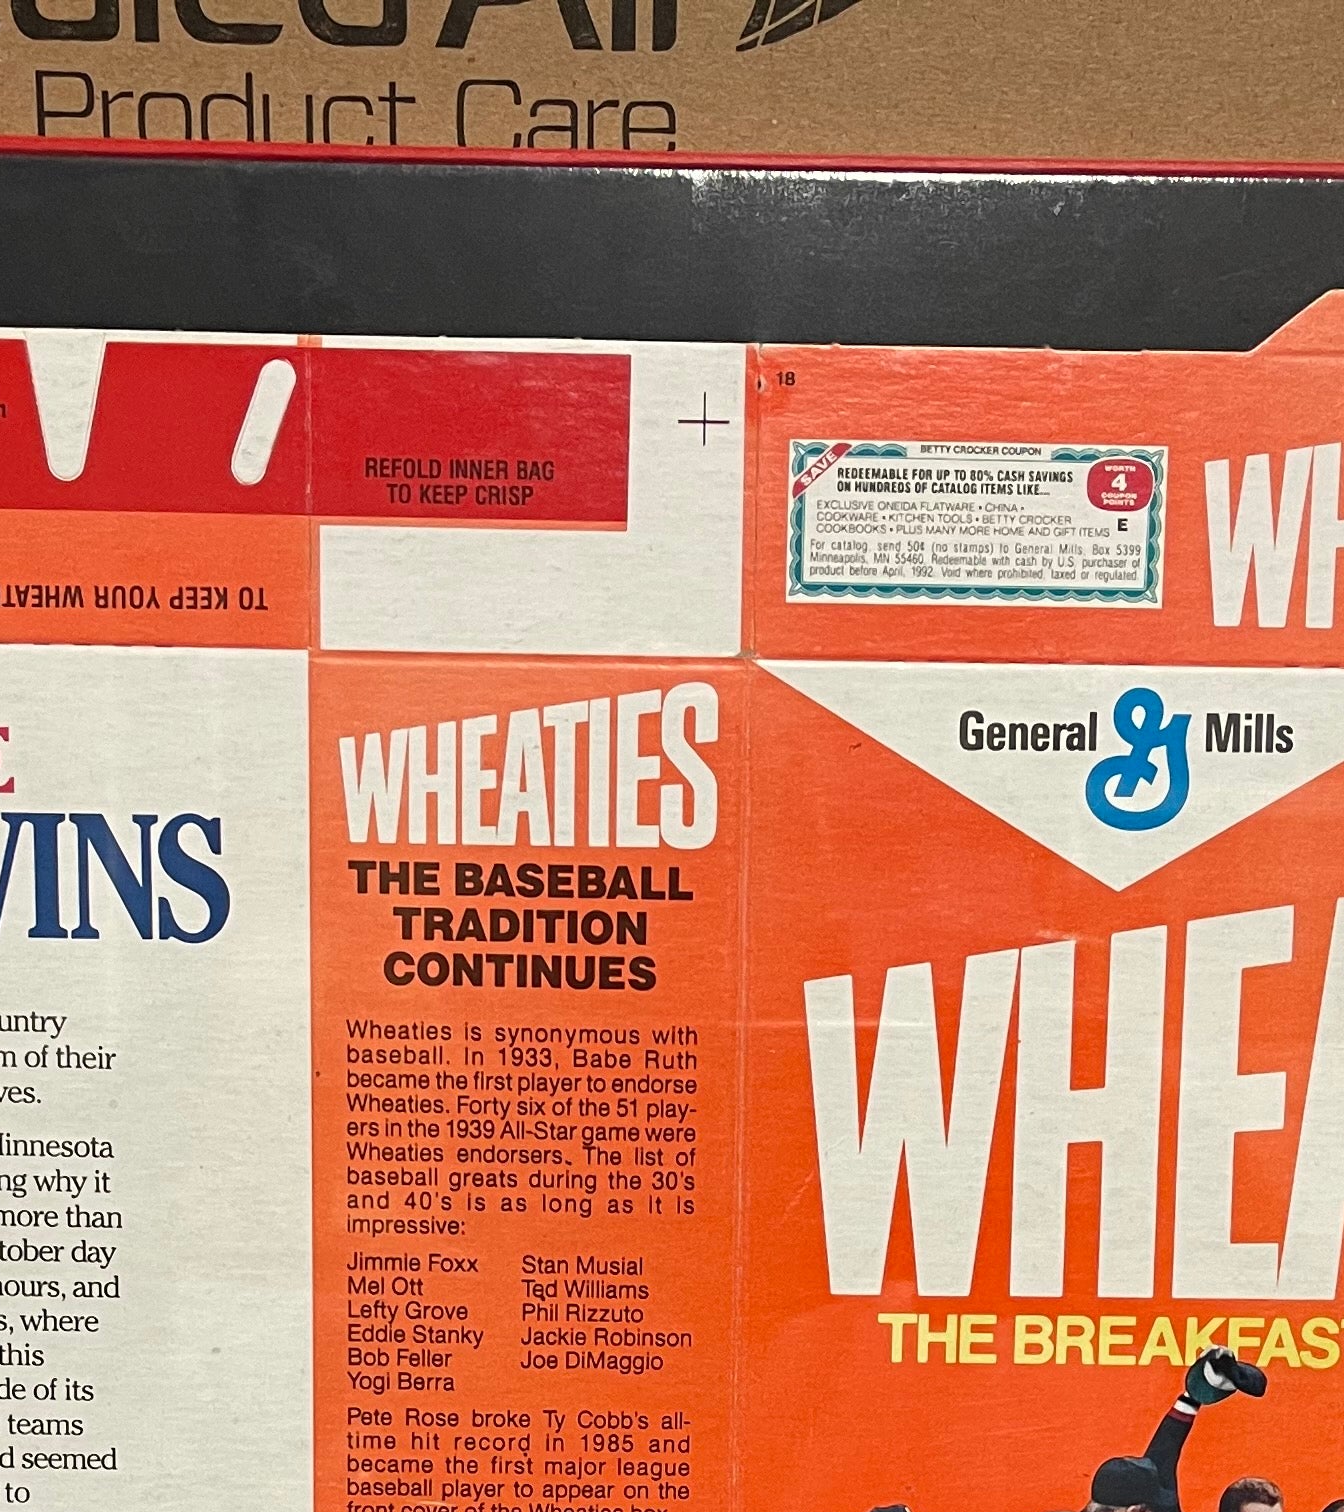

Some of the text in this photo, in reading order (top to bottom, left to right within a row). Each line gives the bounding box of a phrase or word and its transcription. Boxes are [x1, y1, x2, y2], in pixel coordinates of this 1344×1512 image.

[35, 70, 676, 151] Product Care
[776, 371, 795, 386] 18
[921, 445, 1042, 456] BETTY CROCKER COUPON
[365, 457, 555, 481] REFOLD INNER BAG
[800, 450, 838, 486] SAVE
[838, 468, 1073, 483] REDEEMABLE FOR UP TO 80% CASH SAVINGS
[385, 484, 534, 505] TO KEEP CRISP
[94, 584, 160, 609] YOUR
[170, 585, 227, 610] KEEP
[239, 586, 268, 610] TO
[959, 711, 1294, 753] General Mills
[339, 682, 719, 850] WHEATIES
[348, 860, 693, 901] THE BASEBALL
[393, 906, 646, 945] TRADITION
[383, 951, 657, 991] CONTINUES
[521, 1327, 692, 1348] Jackie Robinson
[878, 1313, 997, 1365] THE
